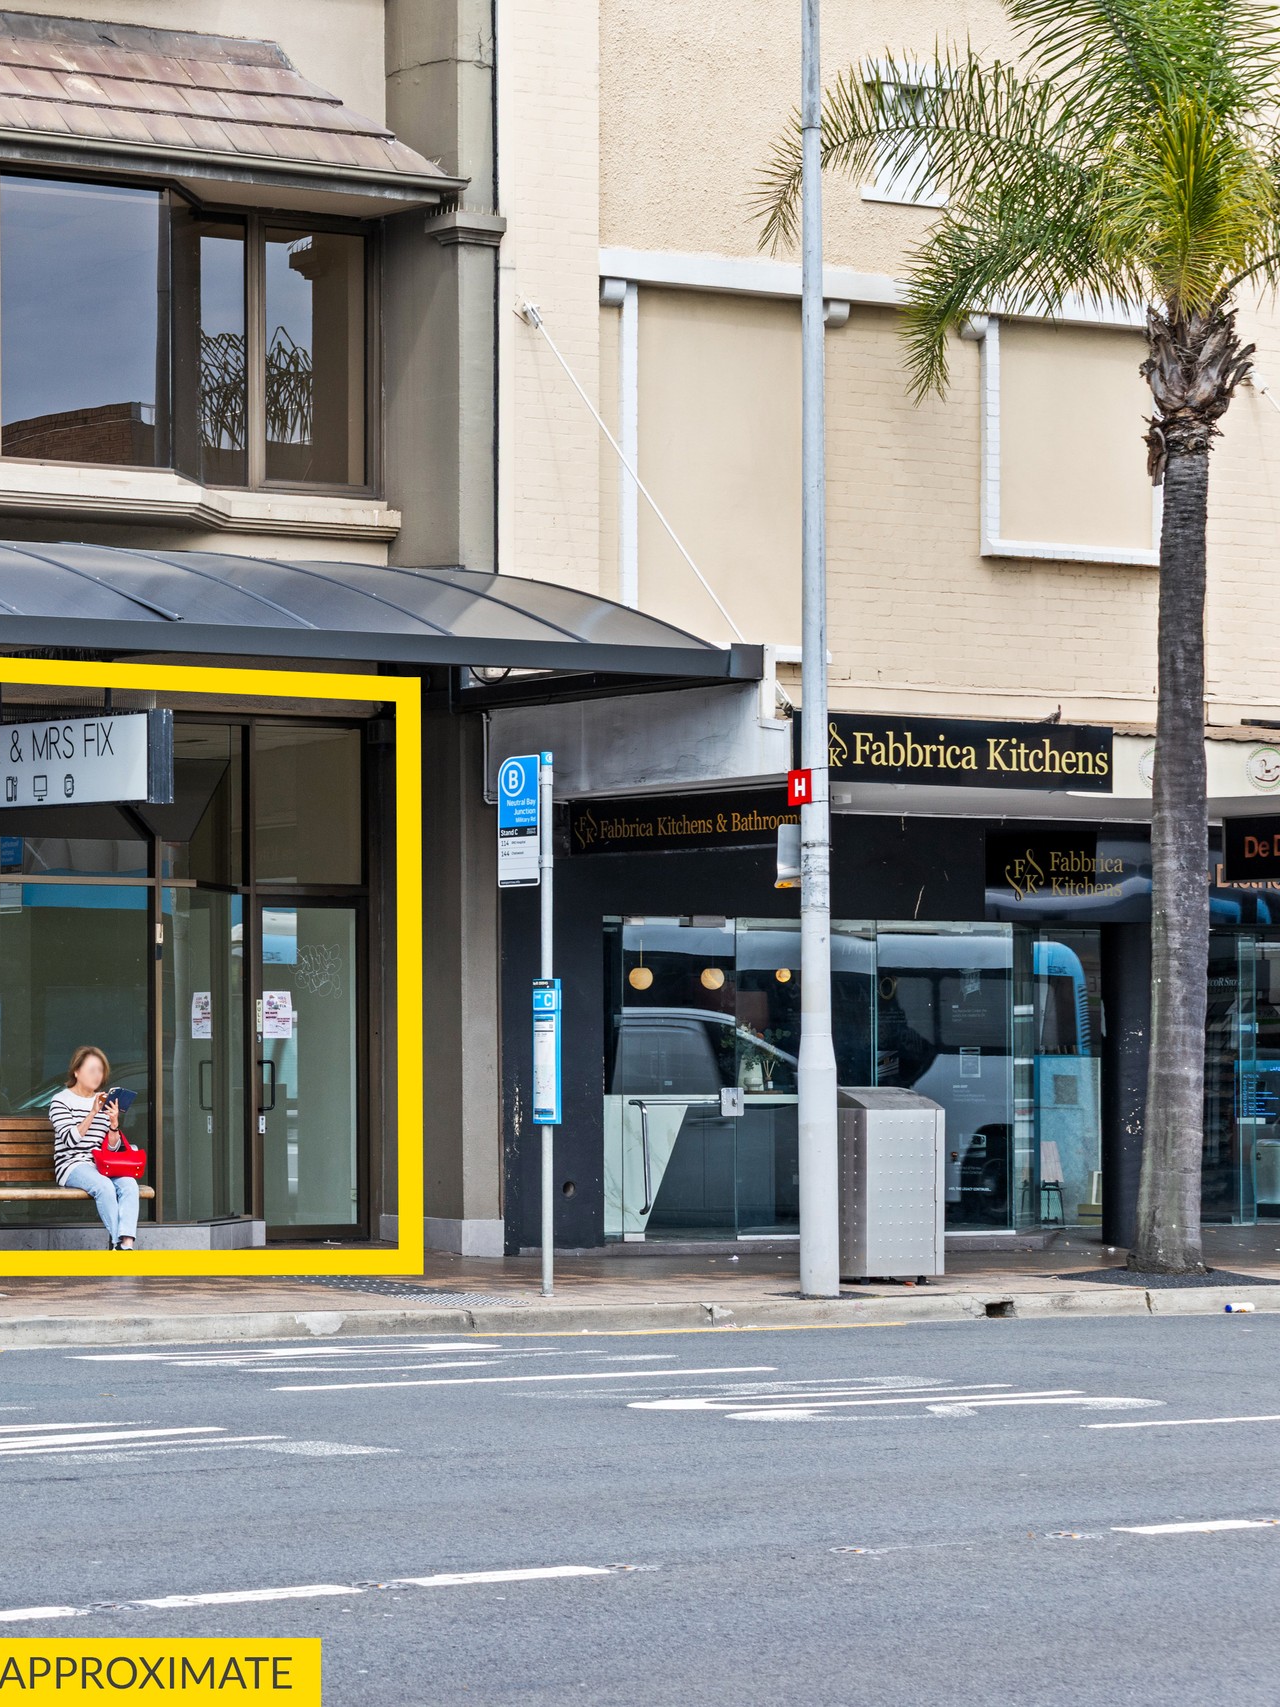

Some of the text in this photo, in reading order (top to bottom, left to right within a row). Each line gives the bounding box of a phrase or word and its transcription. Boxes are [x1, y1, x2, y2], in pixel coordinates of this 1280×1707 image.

[9, 730, 23, 763] &
[32, 725, 74, 761] MRS
[83, 721, 114, 757] FIX
[852, 731, 978, 770] Fabbrica
[986, 737, 1109, 776] Kitchens
[794, 777, 806, 797] H
[506, 798, 536, 807] Neutral Bay
[514, 808, 536, 816] Junction
[500, 829, 514, 837] Stand
[600, 817, 654, 839] Fabbrica
[657, 814, 713, 835] Kitchens
[716, 813, 727, 833] &
[1244, 836, 1270, 858] De
[1050, 851, 1124, 873] Fabbrica
[1051, 876, 1123, 897] Kitchens
